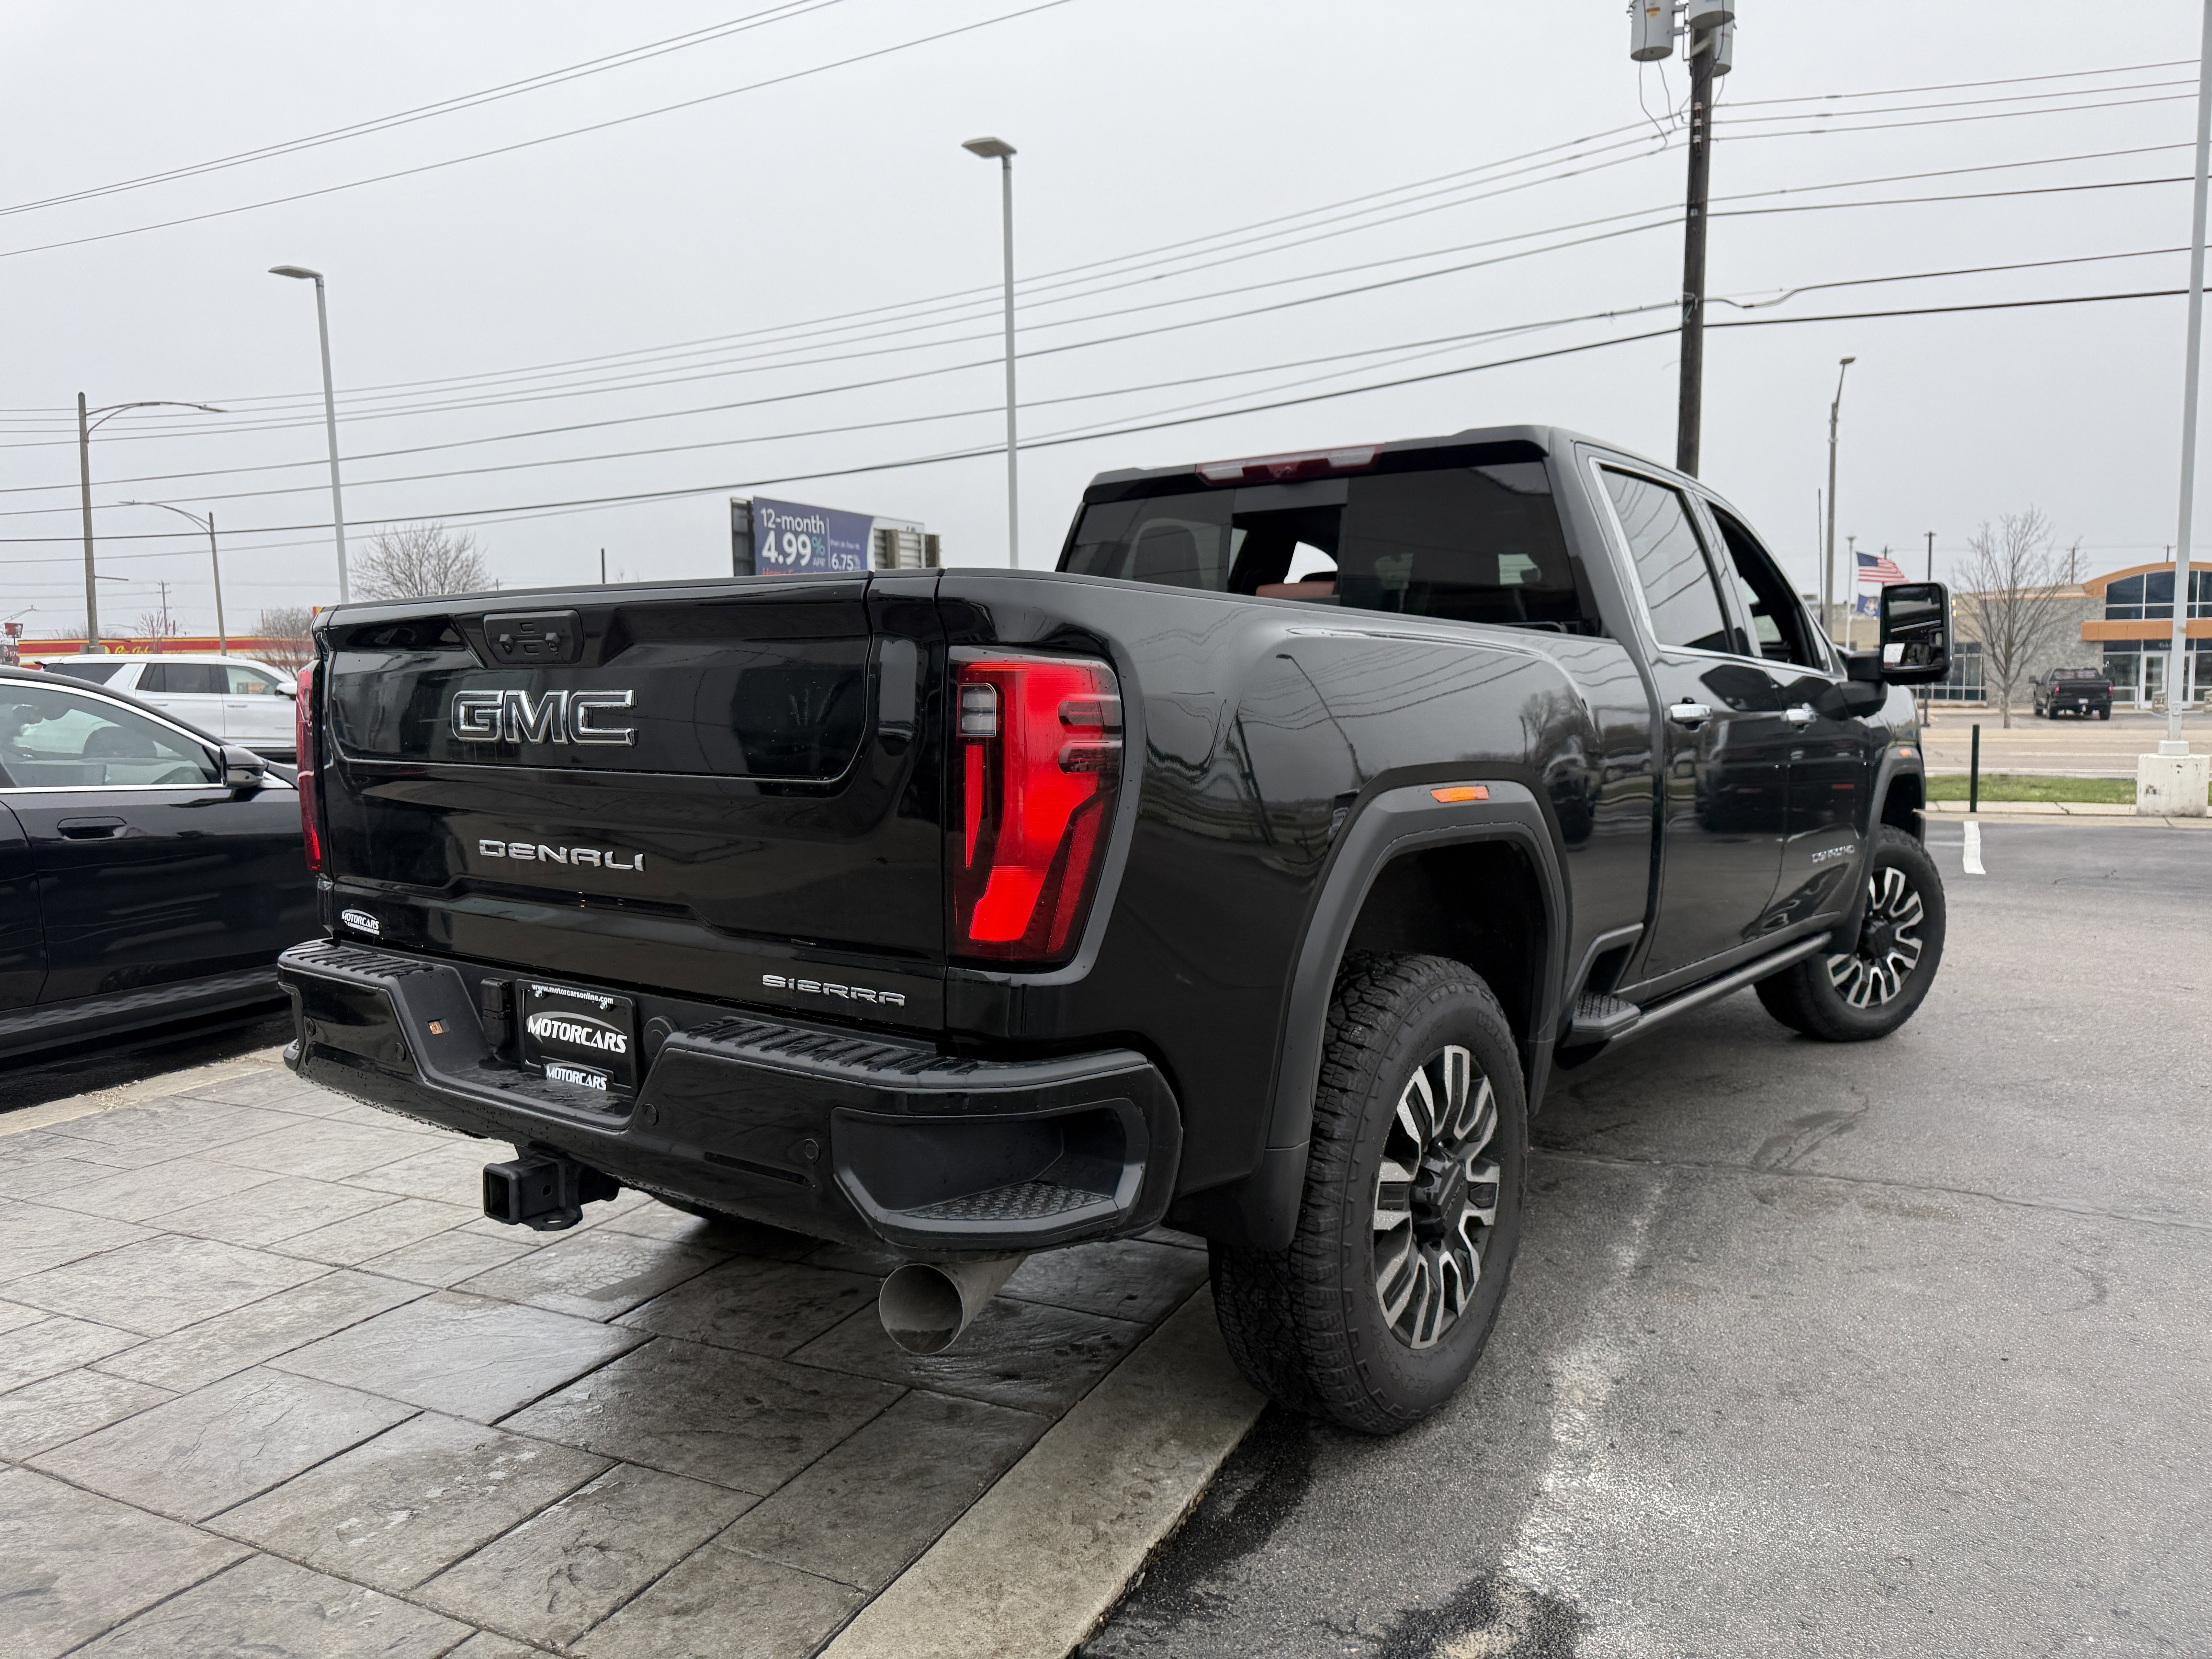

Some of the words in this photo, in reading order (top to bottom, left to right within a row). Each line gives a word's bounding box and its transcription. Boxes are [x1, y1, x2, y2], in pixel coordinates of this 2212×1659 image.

[761, 507, 825, 535] 12-month
[452, 689, 638, 747] GMC
[479, 839, 646, 872] DENALI
[341, 911, 380, 930] MOTORCARS
[531, 984, 614, 1005] www.motorcarsonline.com
[762, 974, 905, 1007] SIERRA
[527, 1015, 628, 1054] MOTORCARS
[546, 1065, 607, 1091] MOTORCARS
